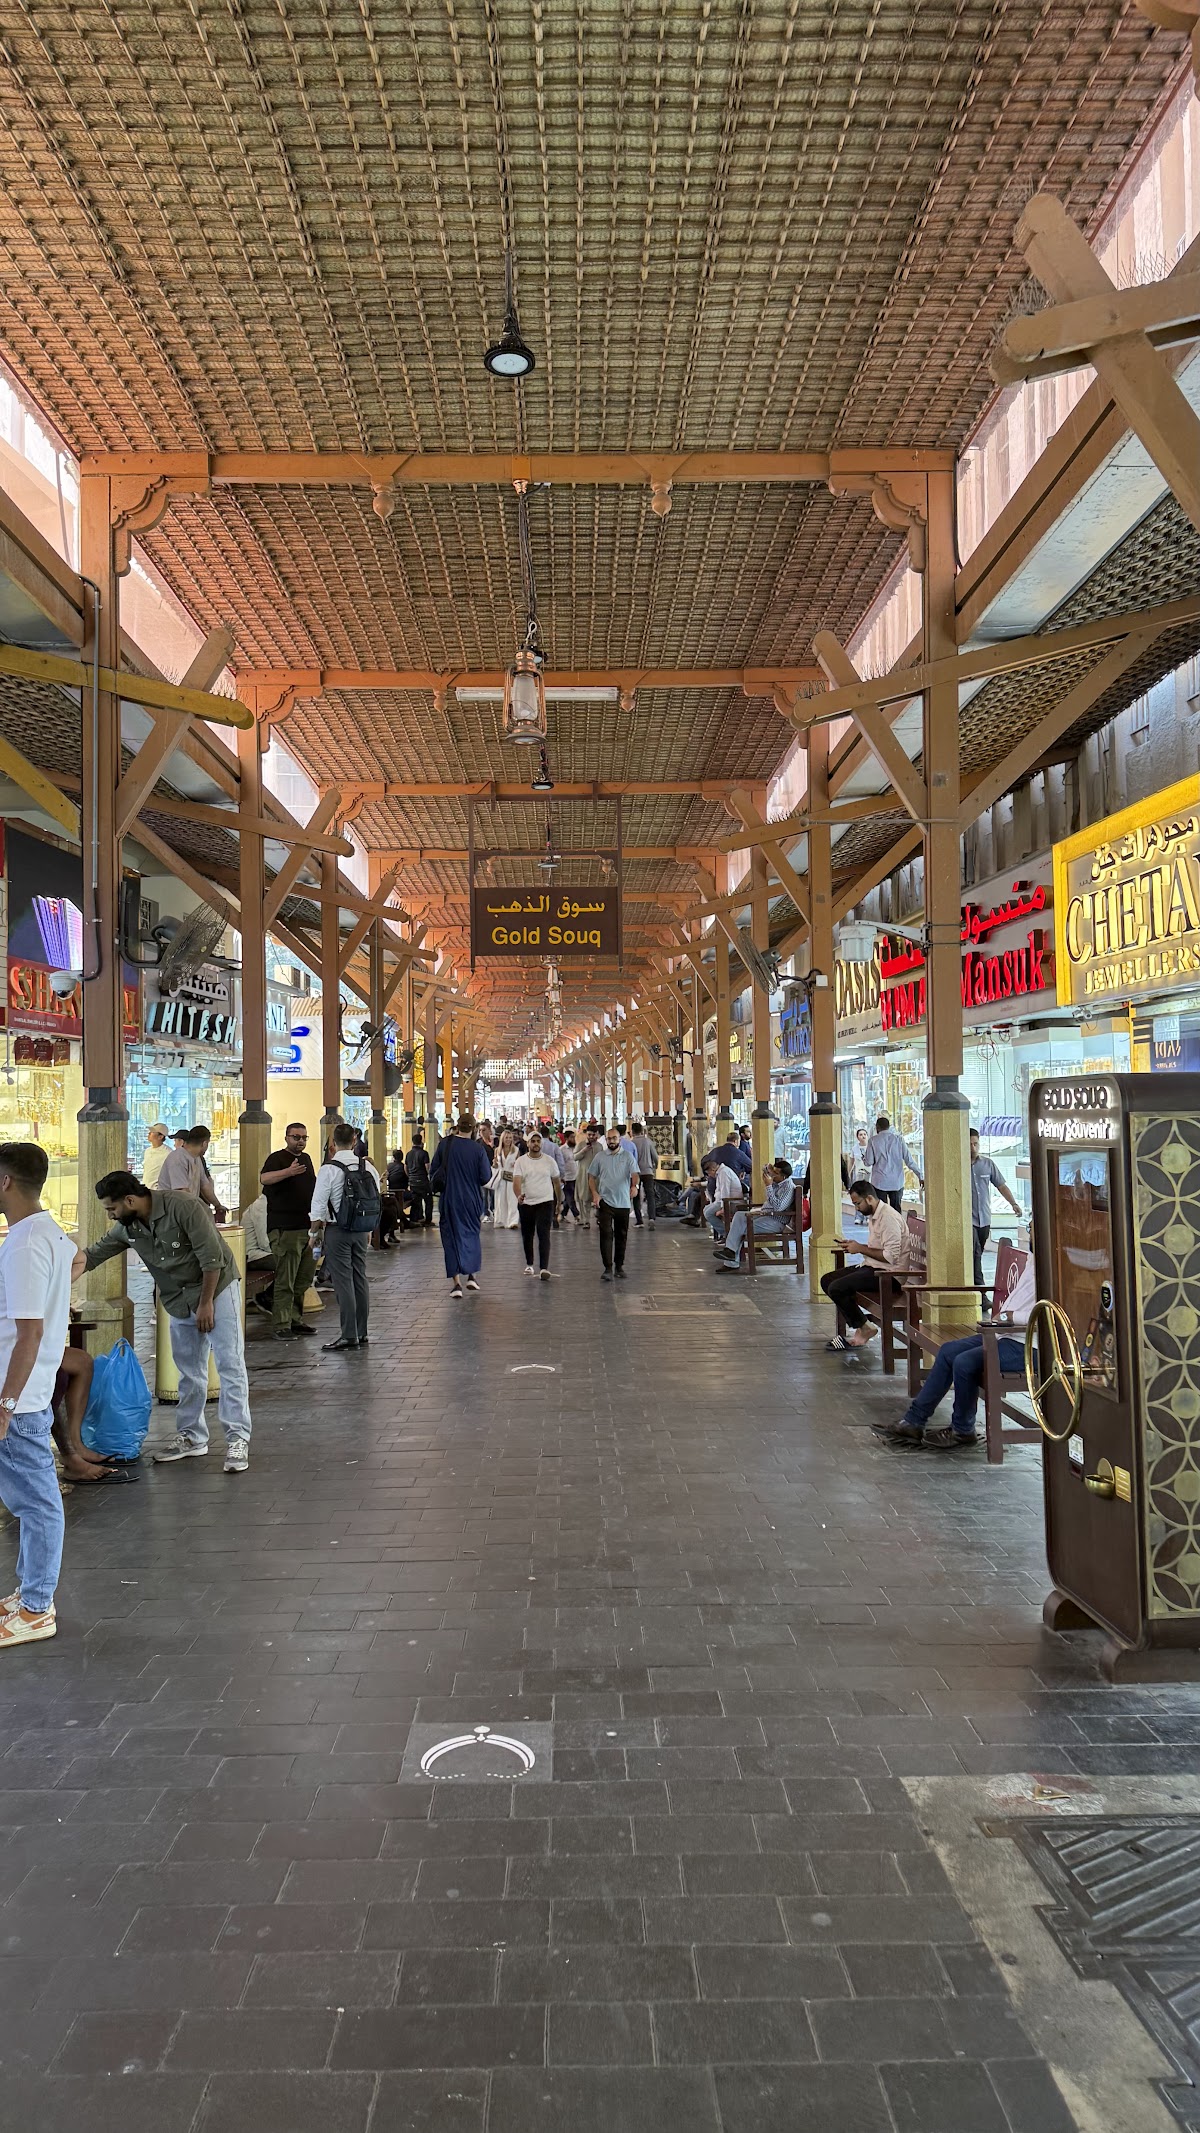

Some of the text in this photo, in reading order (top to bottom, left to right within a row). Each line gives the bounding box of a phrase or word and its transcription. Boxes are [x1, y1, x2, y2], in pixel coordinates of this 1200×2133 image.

[1121, 817, 1199, 863] مجوهرات
[487, 895, 605, 918] سوق الذهب
[491, 926, 601, 948] Gold Souq
[1084, 943, 1200, 994] JEWELLERS
[161, 1002, 237, 1044] HITESH
[1043, 1086, 1108, 1110] GOLD SOUQ
[1037, 1118, 1109, 1142] Penny Souvenir
